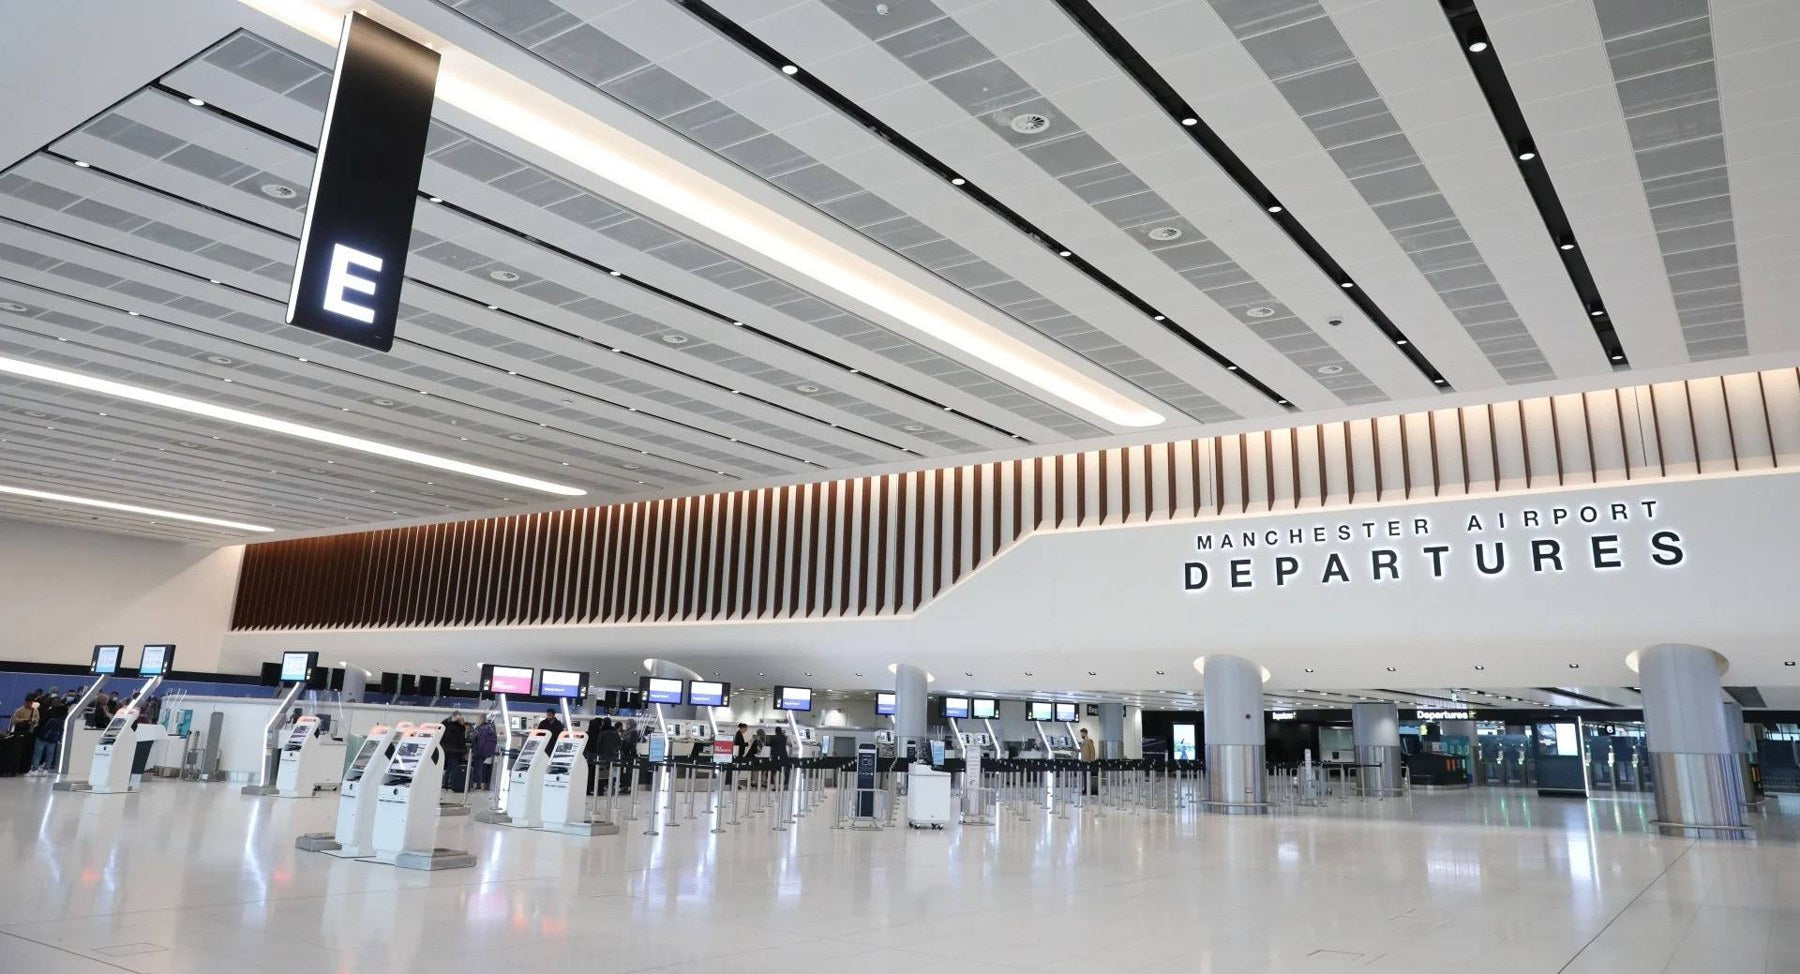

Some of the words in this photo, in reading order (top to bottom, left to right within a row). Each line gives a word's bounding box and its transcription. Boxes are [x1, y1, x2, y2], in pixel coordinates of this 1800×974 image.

[323, 242, 384, 324] E
[1197, 518, 1429, 550] MANCHESTER
[1467, 500, 1658, 532] AIRPORT
[1184, 531, 1684, 590] DEPARTURES
[1416, 710, 1468, 722] Departures
